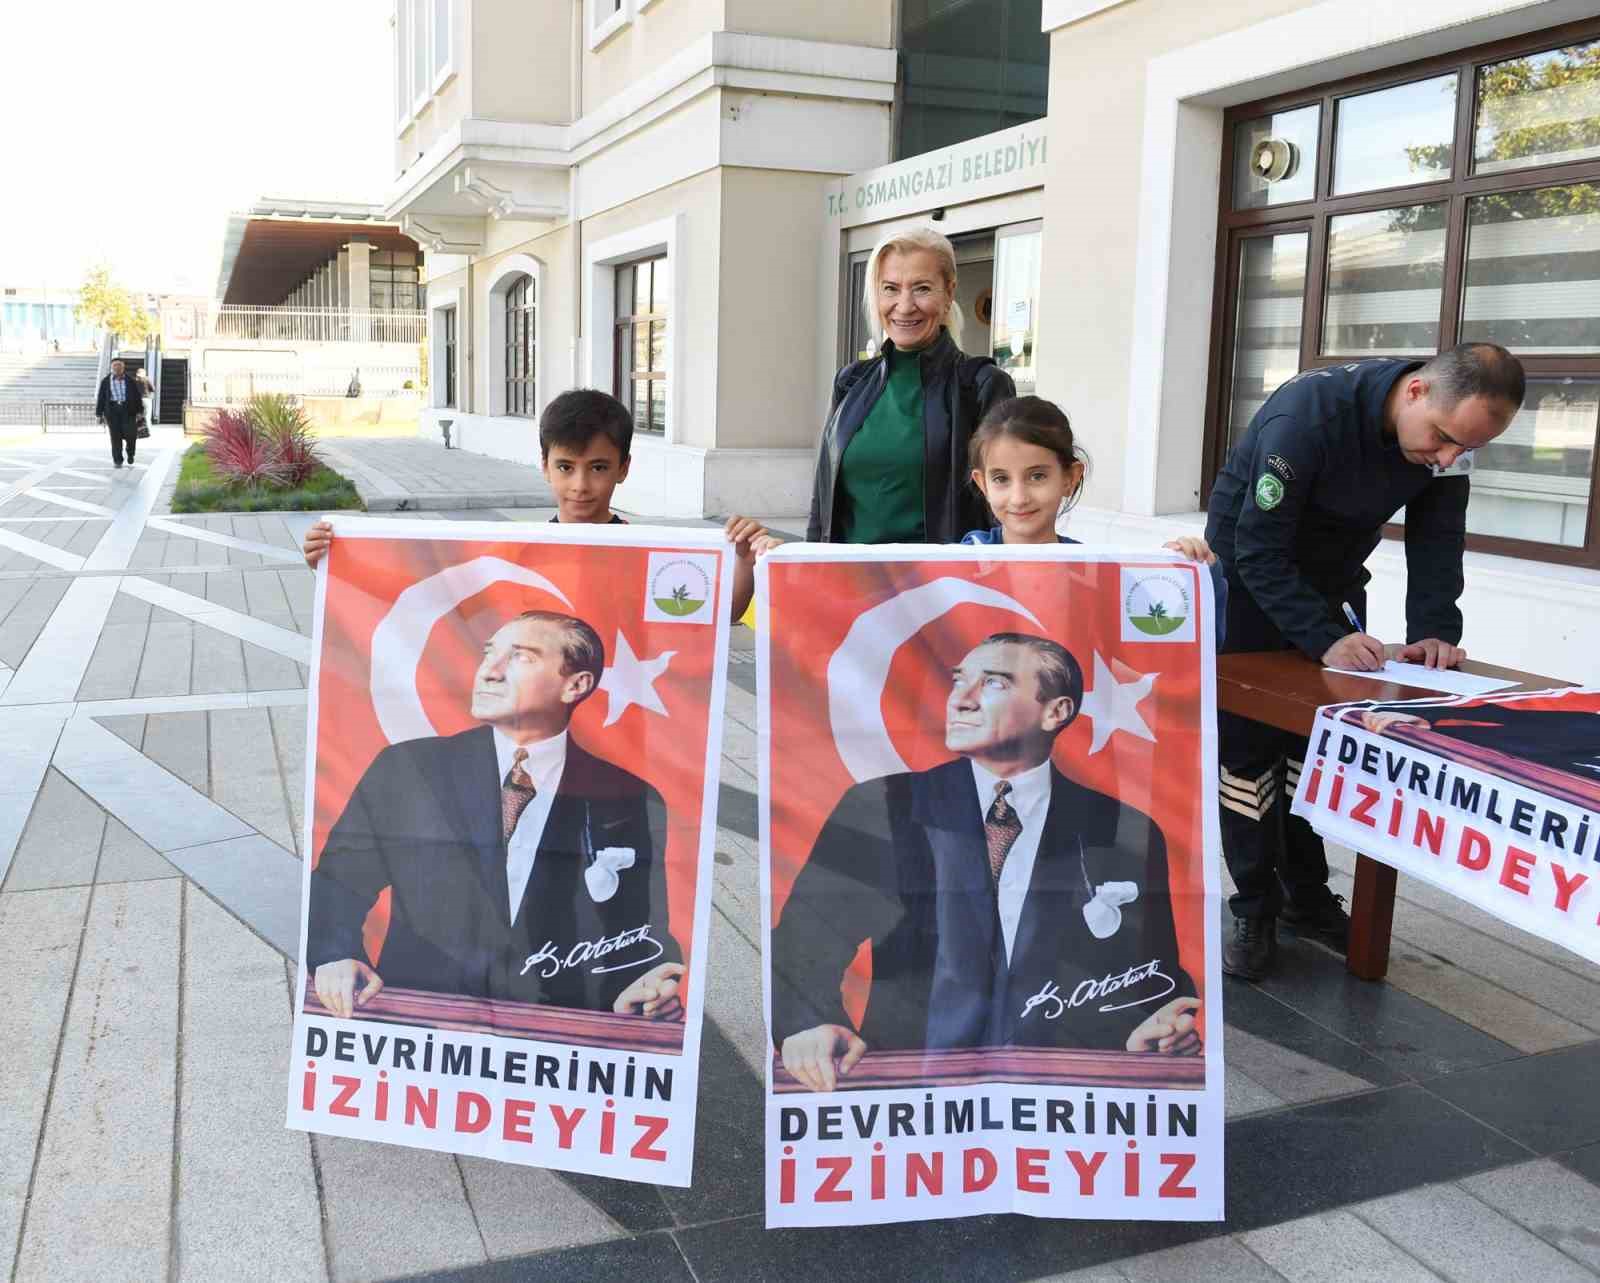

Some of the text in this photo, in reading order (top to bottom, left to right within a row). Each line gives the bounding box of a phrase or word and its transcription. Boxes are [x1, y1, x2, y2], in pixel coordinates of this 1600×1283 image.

[855, 154, 953, 209] OSMANGAZİ
[1337, 733, 1600, 863] DEVRİMLERİ
[1327, 764, 1600, 927] İZİNDEY
[305, 1026, 673, 1102] DEVRİMLERİNİN
[301, 1059, 669, 1162] İZİNDEYİZ
[779, 1093, 1198, 1142] DEVRİMLERİNİN
[779, 1139, 1197, 1204] İZİNDEYİZ
